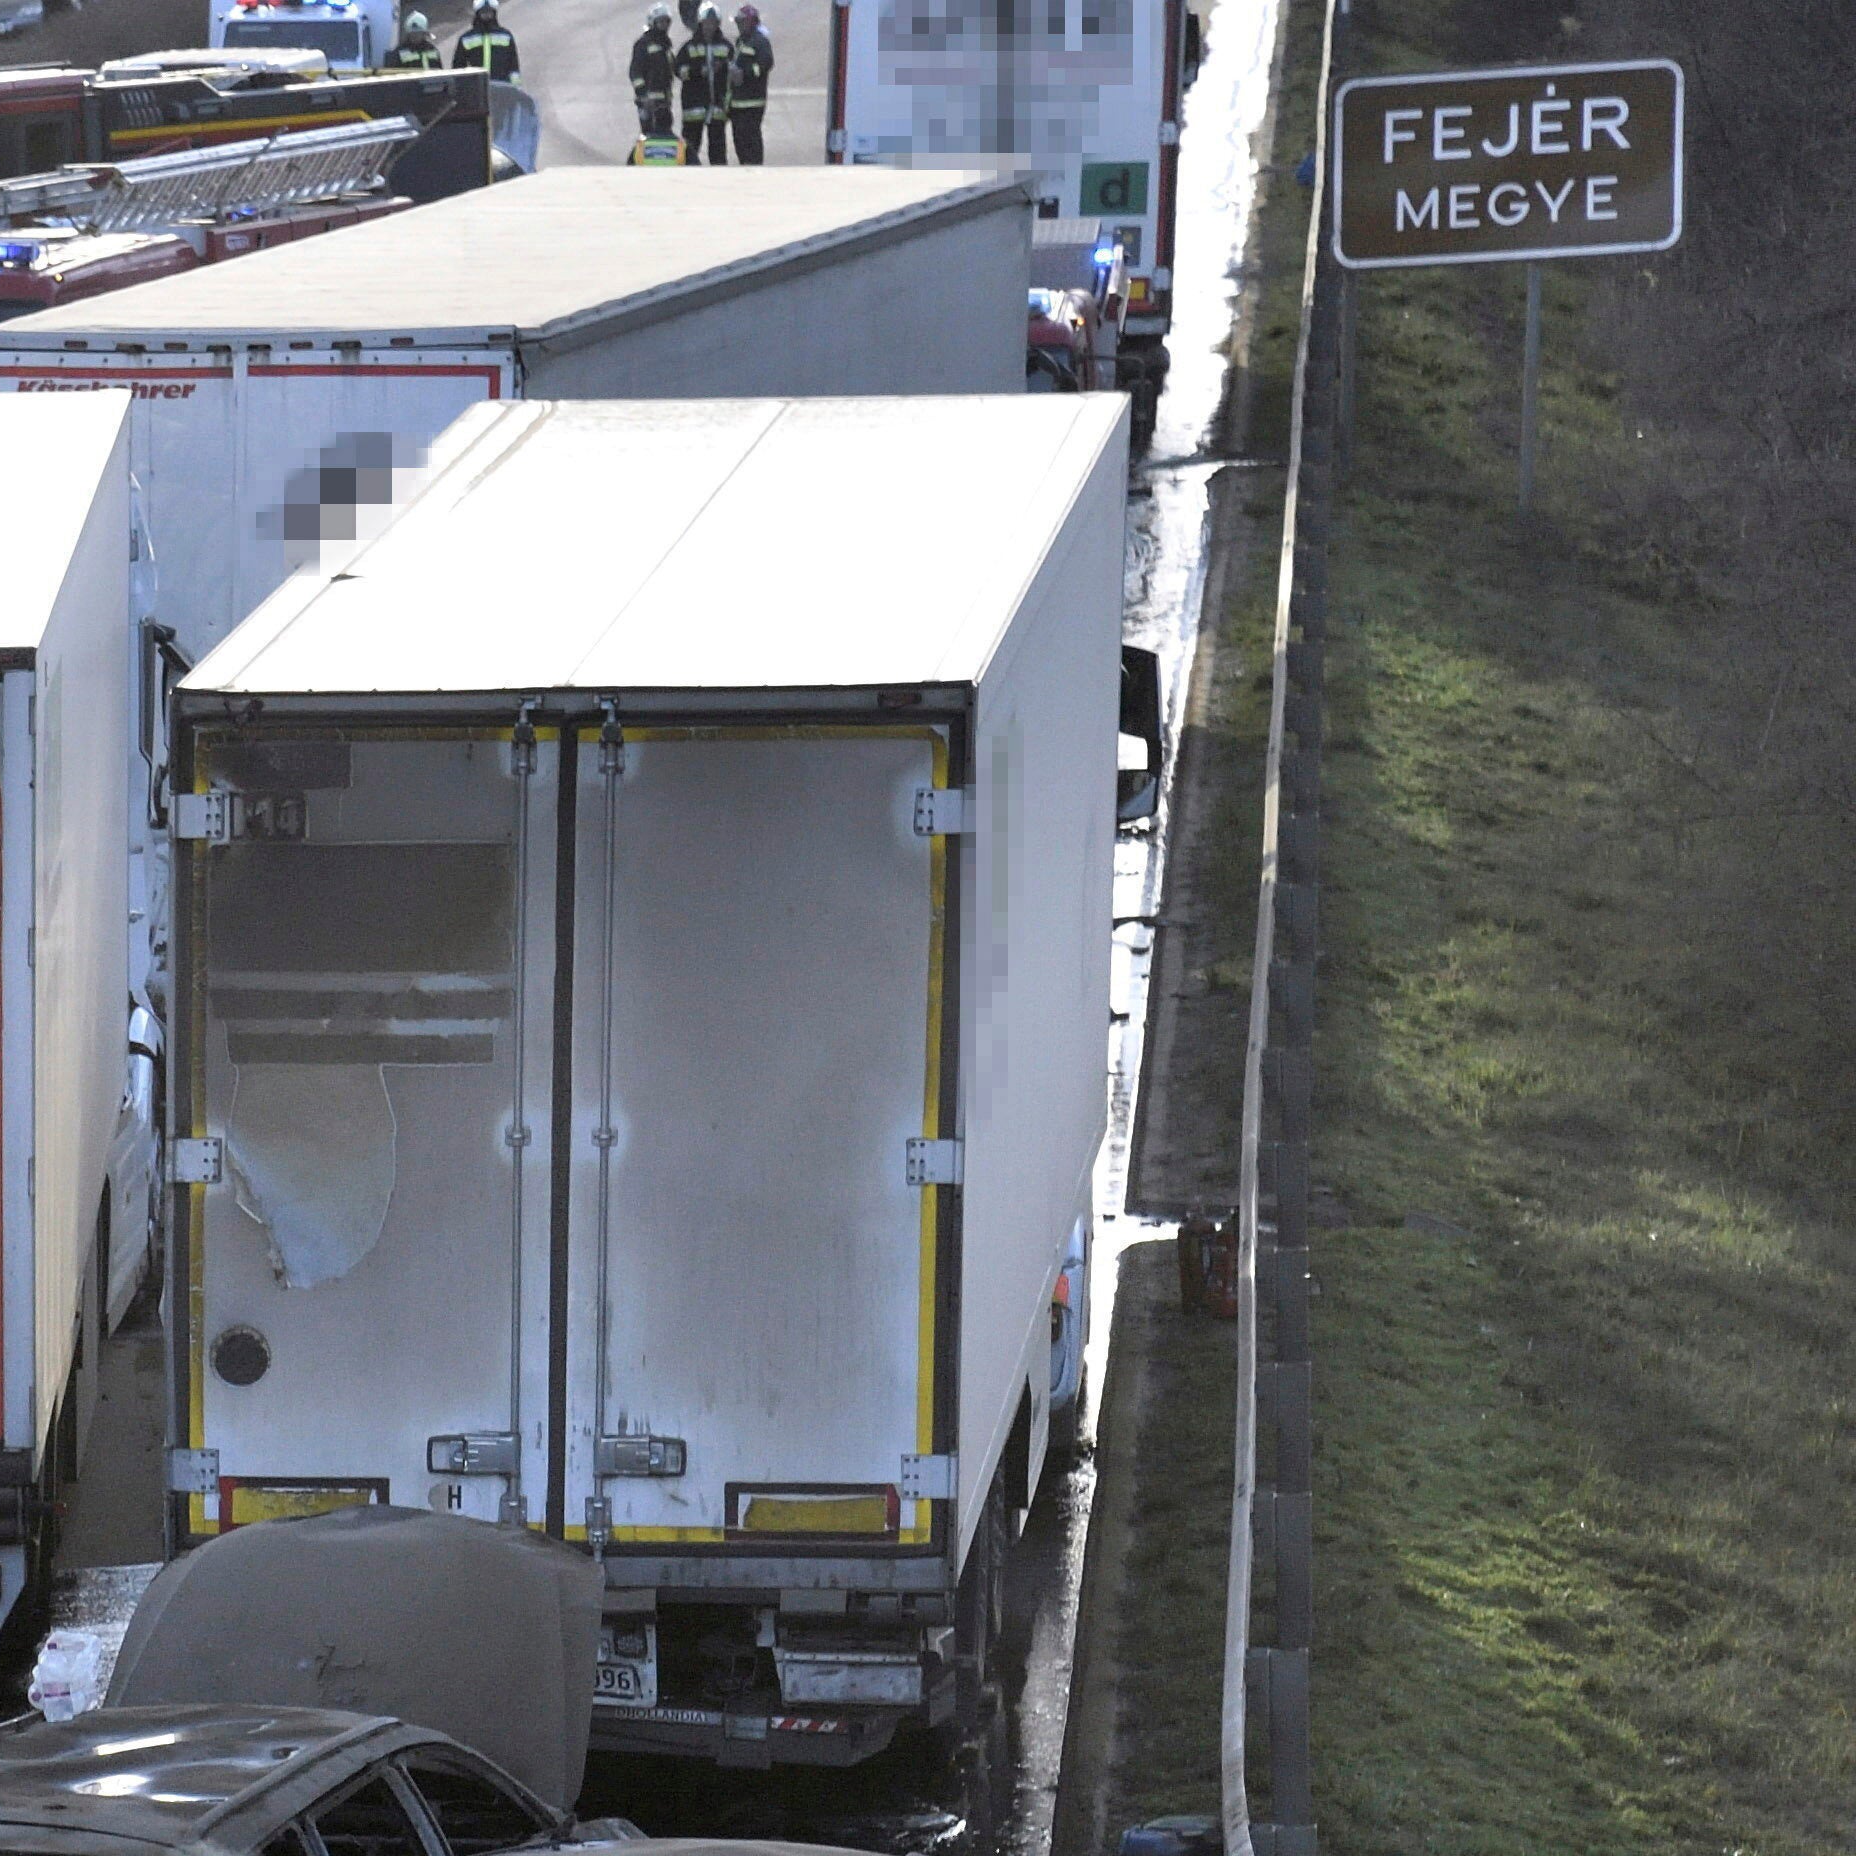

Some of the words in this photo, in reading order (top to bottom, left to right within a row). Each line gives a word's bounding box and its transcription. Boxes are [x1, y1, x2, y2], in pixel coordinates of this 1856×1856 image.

[1383, 82, 1632, 164] FEJÉR
[1098, 167, 1130, 209] d
[1395, 174, 1619, 233] MEGYE
[17, 379, 197, 399] Kässbhrer
